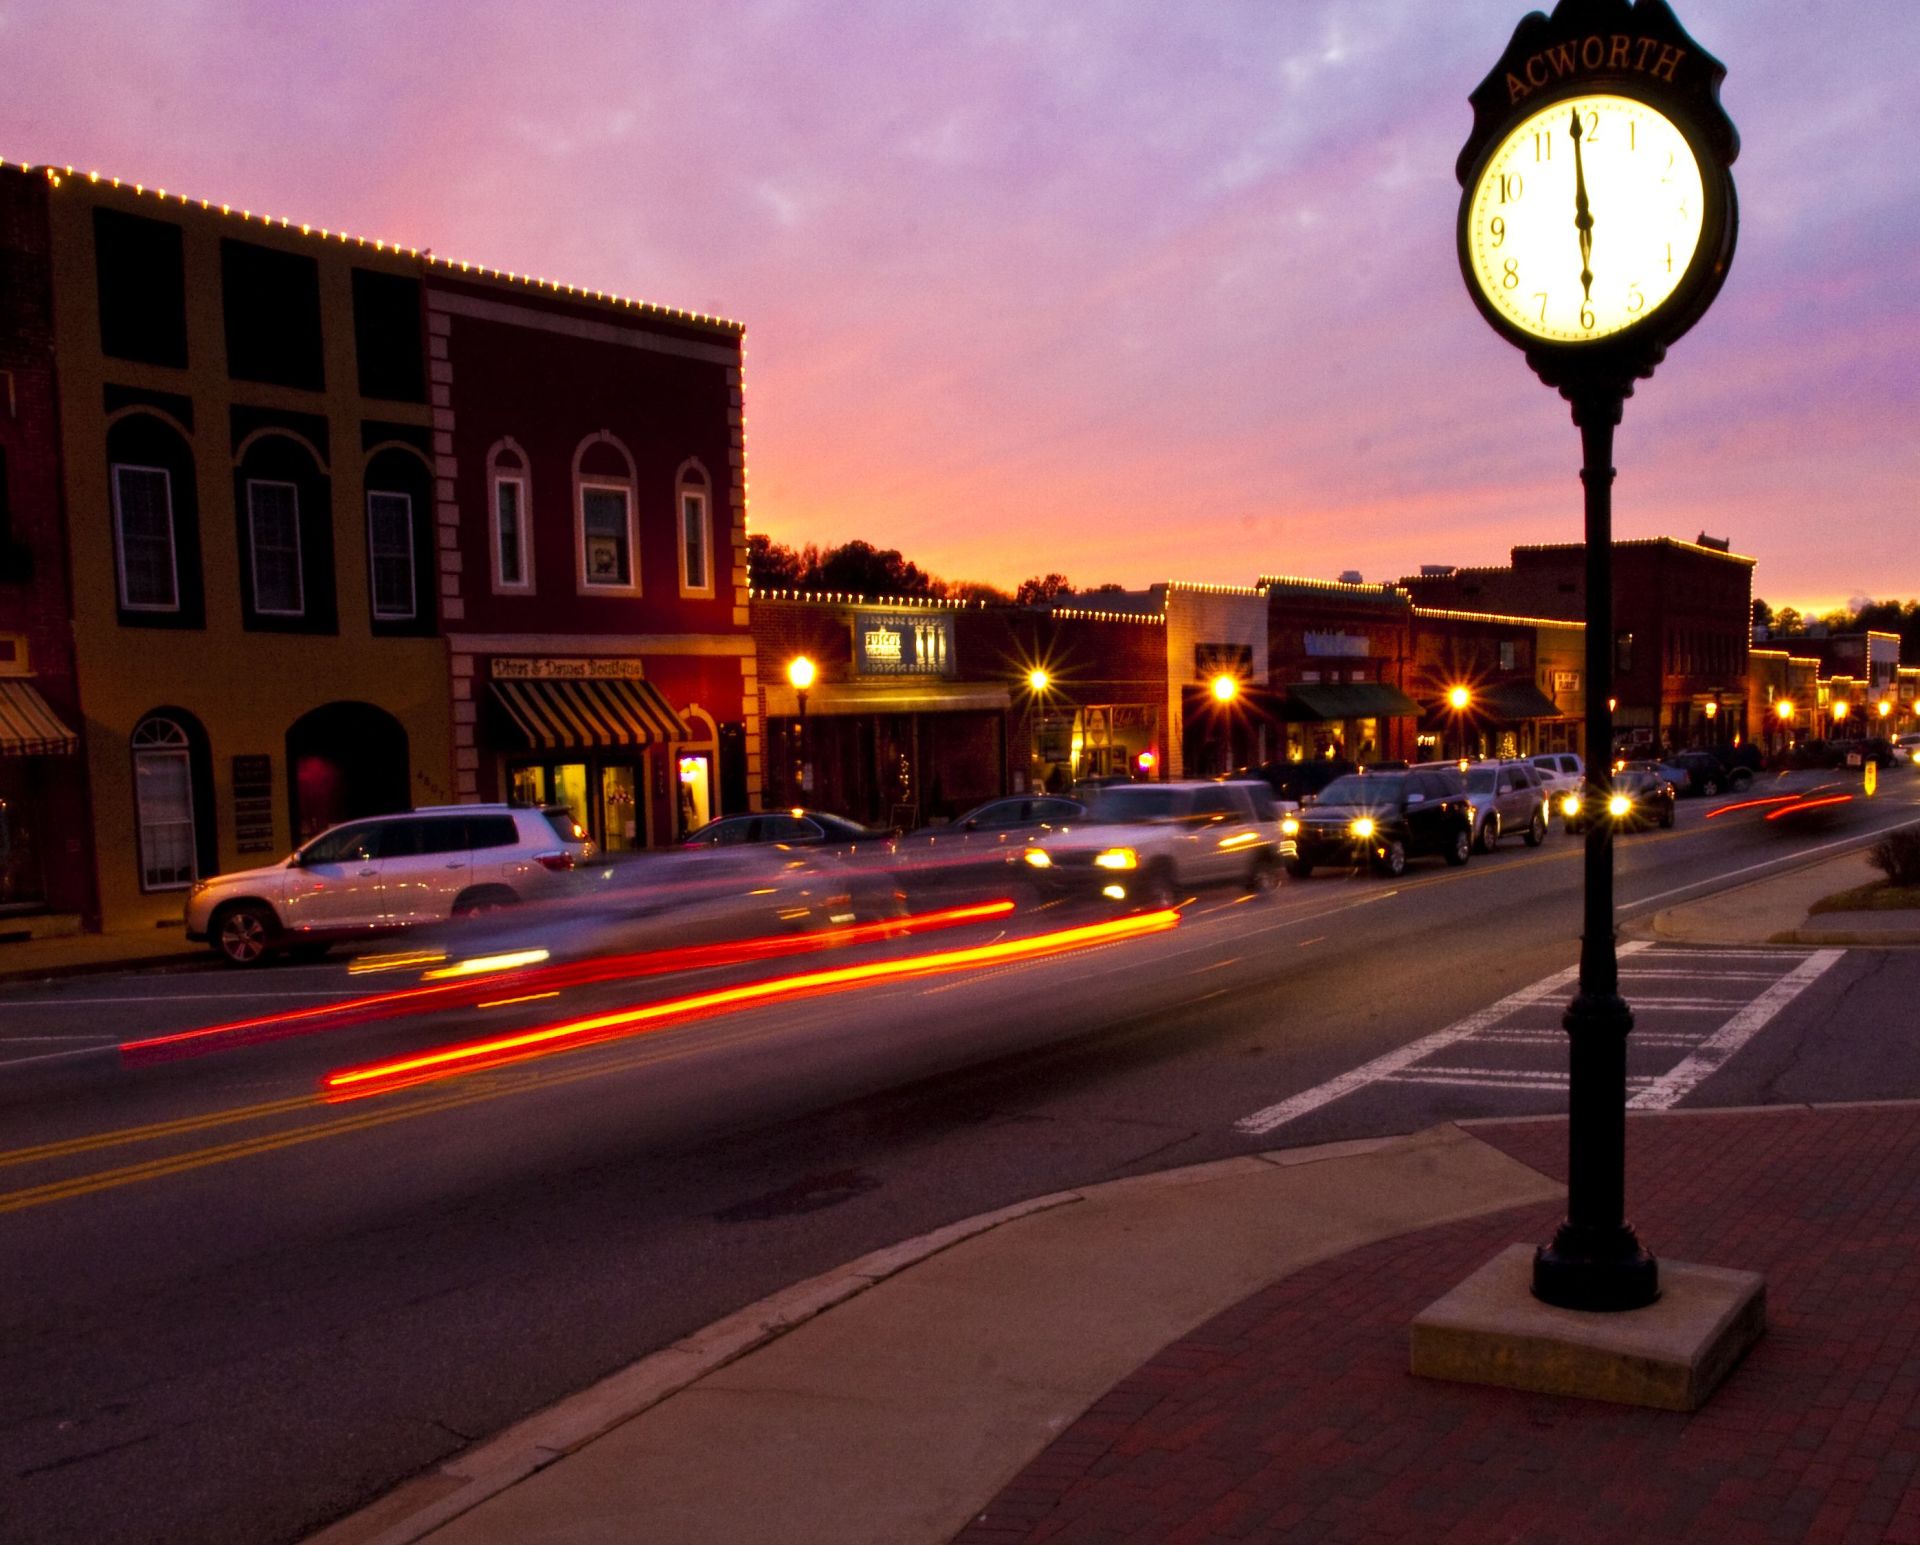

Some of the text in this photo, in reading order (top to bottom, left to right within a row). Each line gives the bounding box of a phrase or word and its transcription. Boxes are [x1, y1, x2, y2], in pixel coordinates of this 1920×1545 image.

[1505, 35, 1686, 104] ACWORTH
[1533, 130, 1551, 162] 11
[1498, 172, 1523, 205] 10
[1490, 216, 1505, 248] 9
[1502, 257, 1519, 289] 8
[1533, 292, 1549, 322] 7
[1626, 282, 1645, 313] 5
[1579, 299, 1596, 330] 6
[589, 660, 641, 678] Boutique
